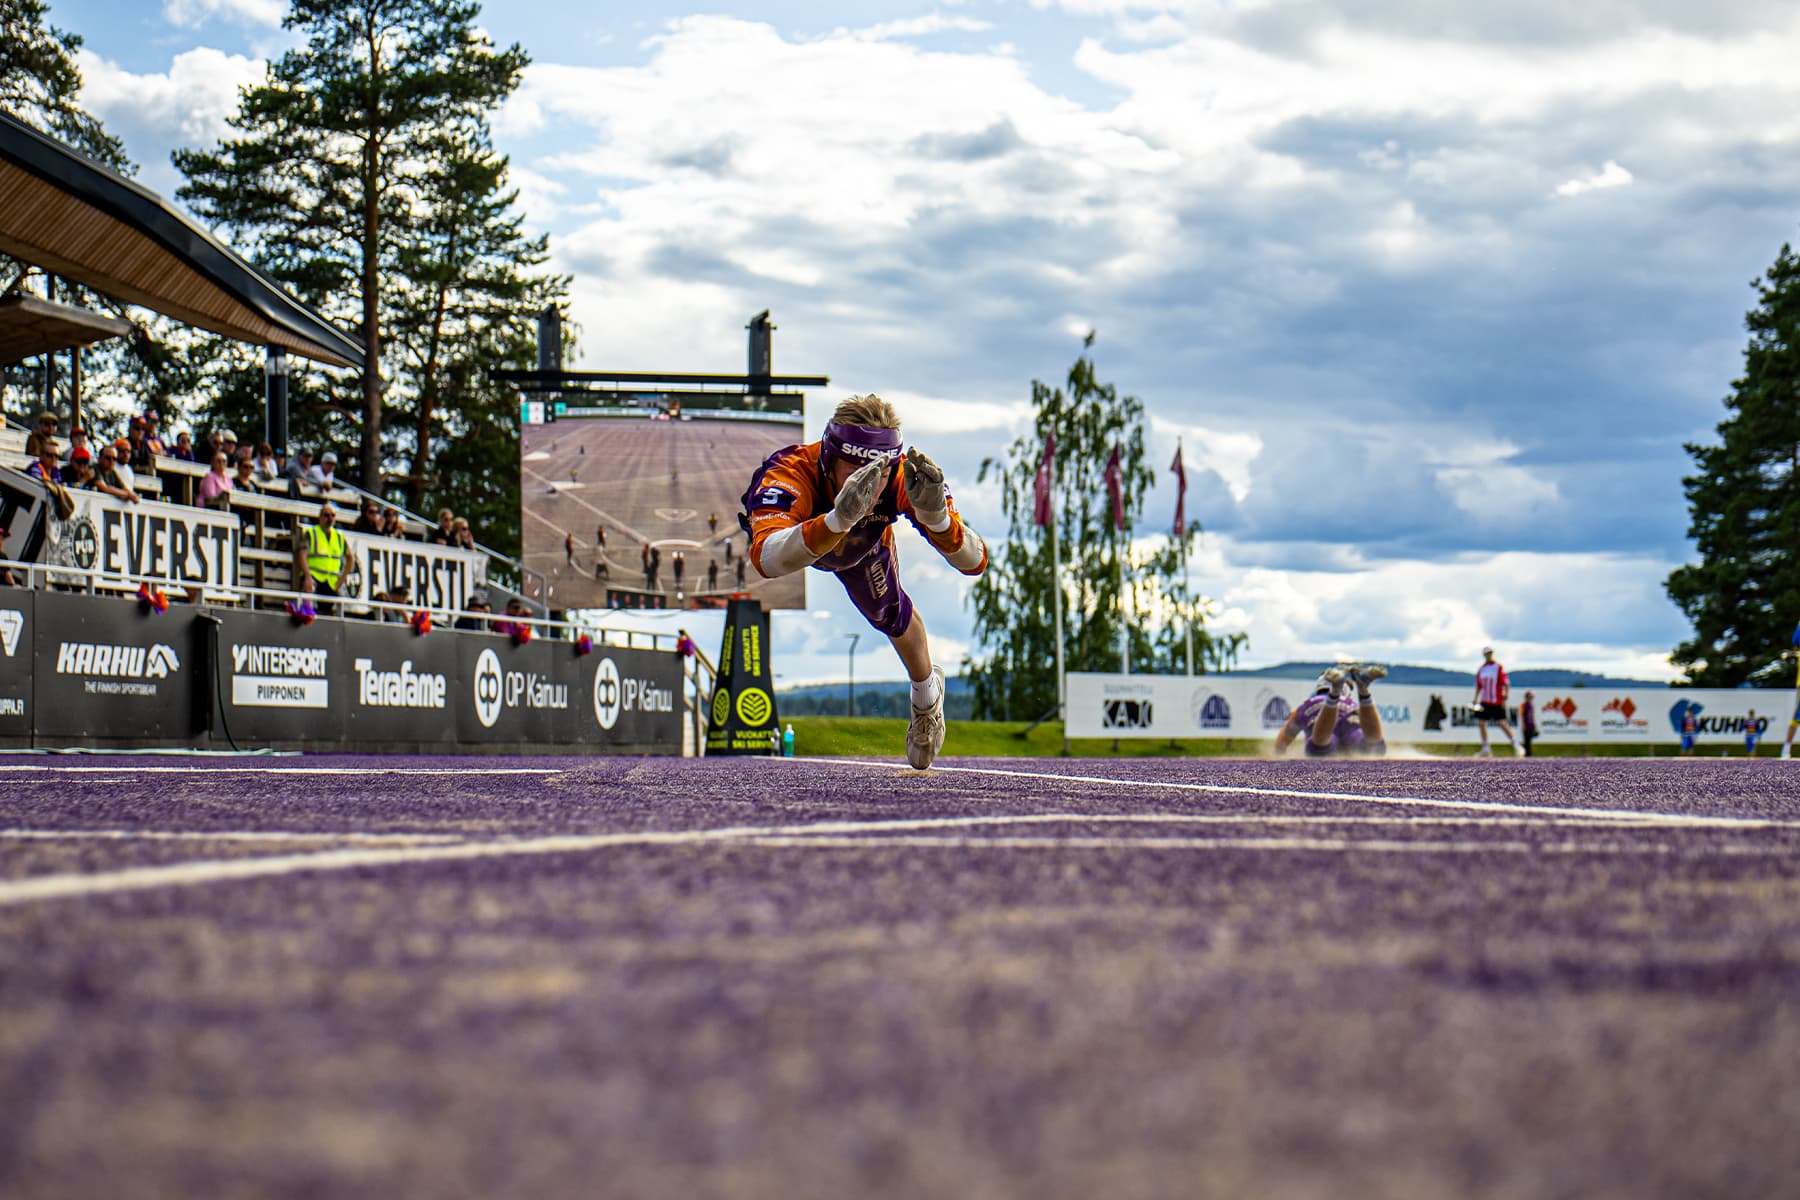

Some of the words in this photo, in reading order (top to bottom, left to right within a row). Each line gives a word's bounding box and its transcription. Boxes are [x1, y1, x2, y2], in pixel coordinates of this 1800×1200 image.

[103, 508, 239, 590] EVERSTI
[368, 547, 465, 612] EVERSTI
[56, 642, 146, 677] KARHU
[248, 645, 328, 676] INTERSPORT
[257, 685, 305, 700] PIIPPONEN
[354, 658, 446, 708] Terrafame
[505, 671, 525, 708] OP
[526, 672, 568, 709] Kainuu
[622, 678, 637, 711] OP
[638, 679, 673, 712] Kainuu
[1700, 716, 1769, 734] KUHO
